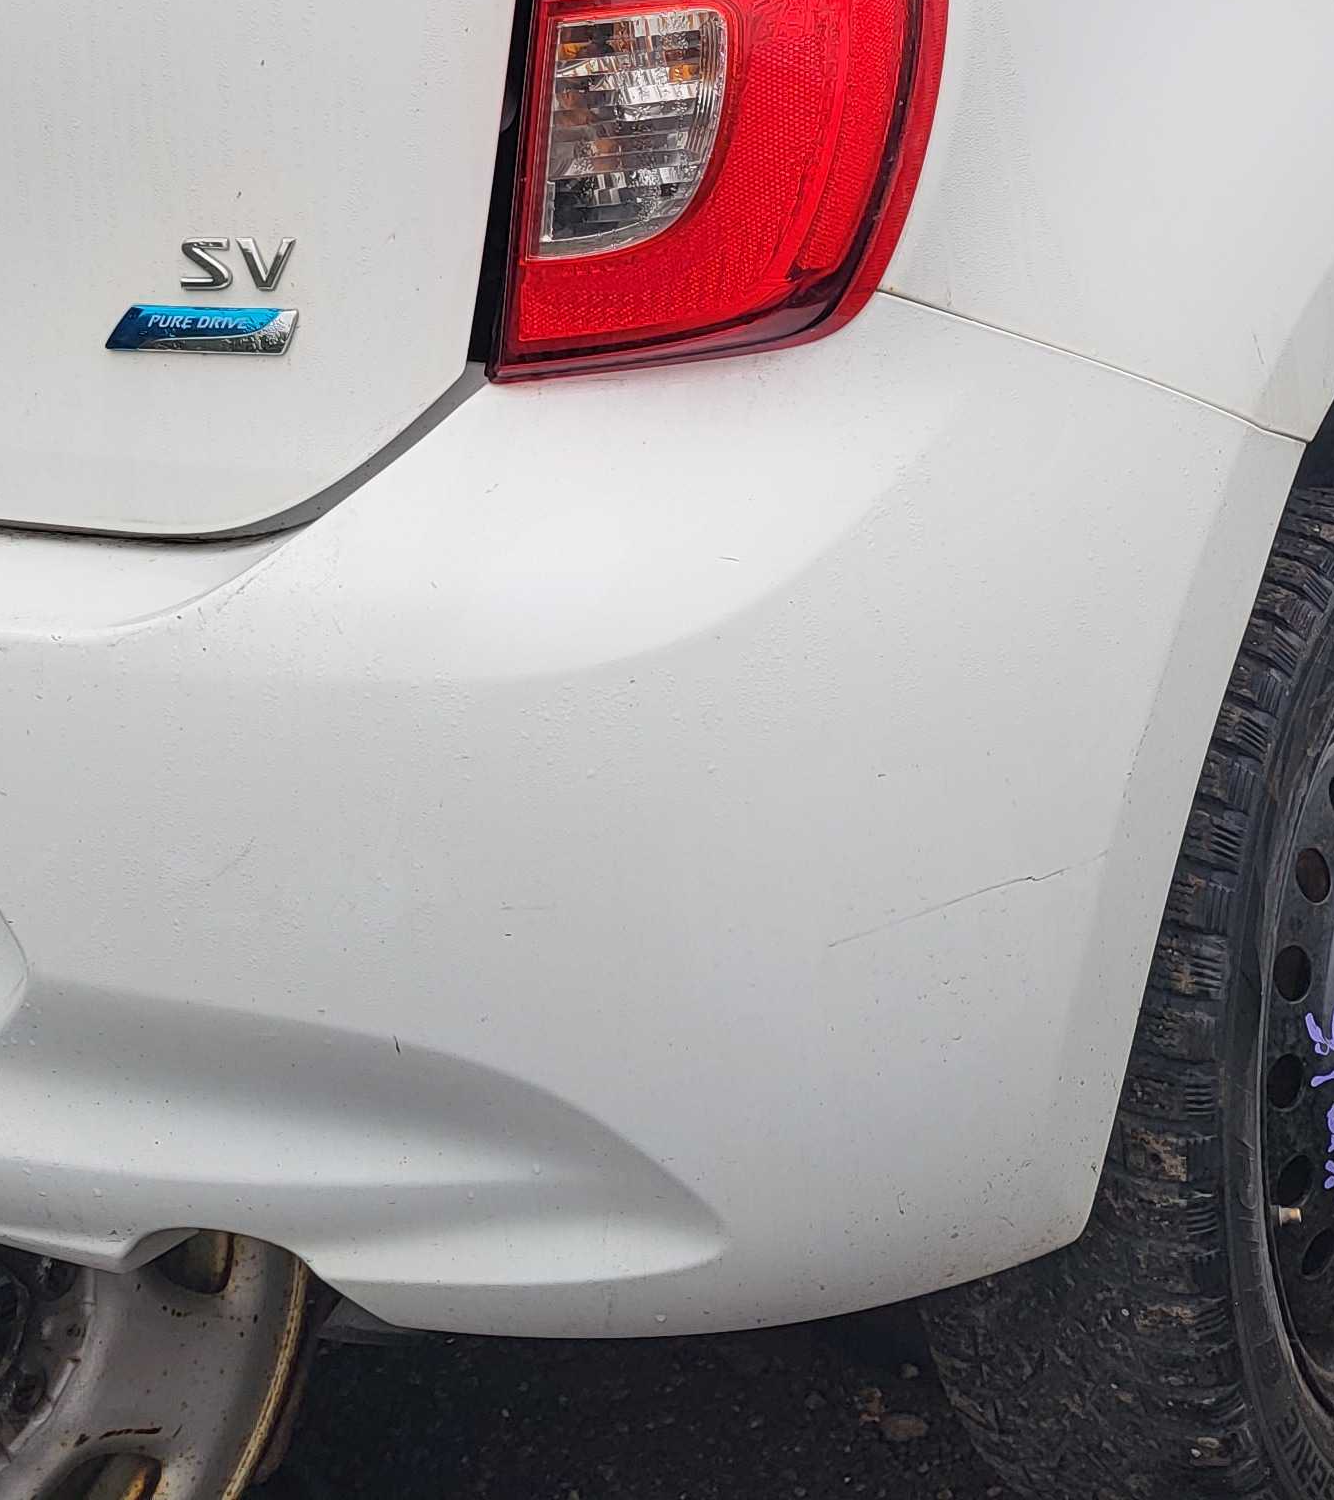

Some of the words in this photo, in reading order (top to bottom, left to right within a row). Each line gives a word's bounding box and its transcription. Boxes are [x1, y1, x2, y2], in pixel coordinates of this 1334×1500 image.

[180, 236, 297, 291] SV
[147, 313, 194, 330] PURE
[195, 315, 249, 331] DRIVE
